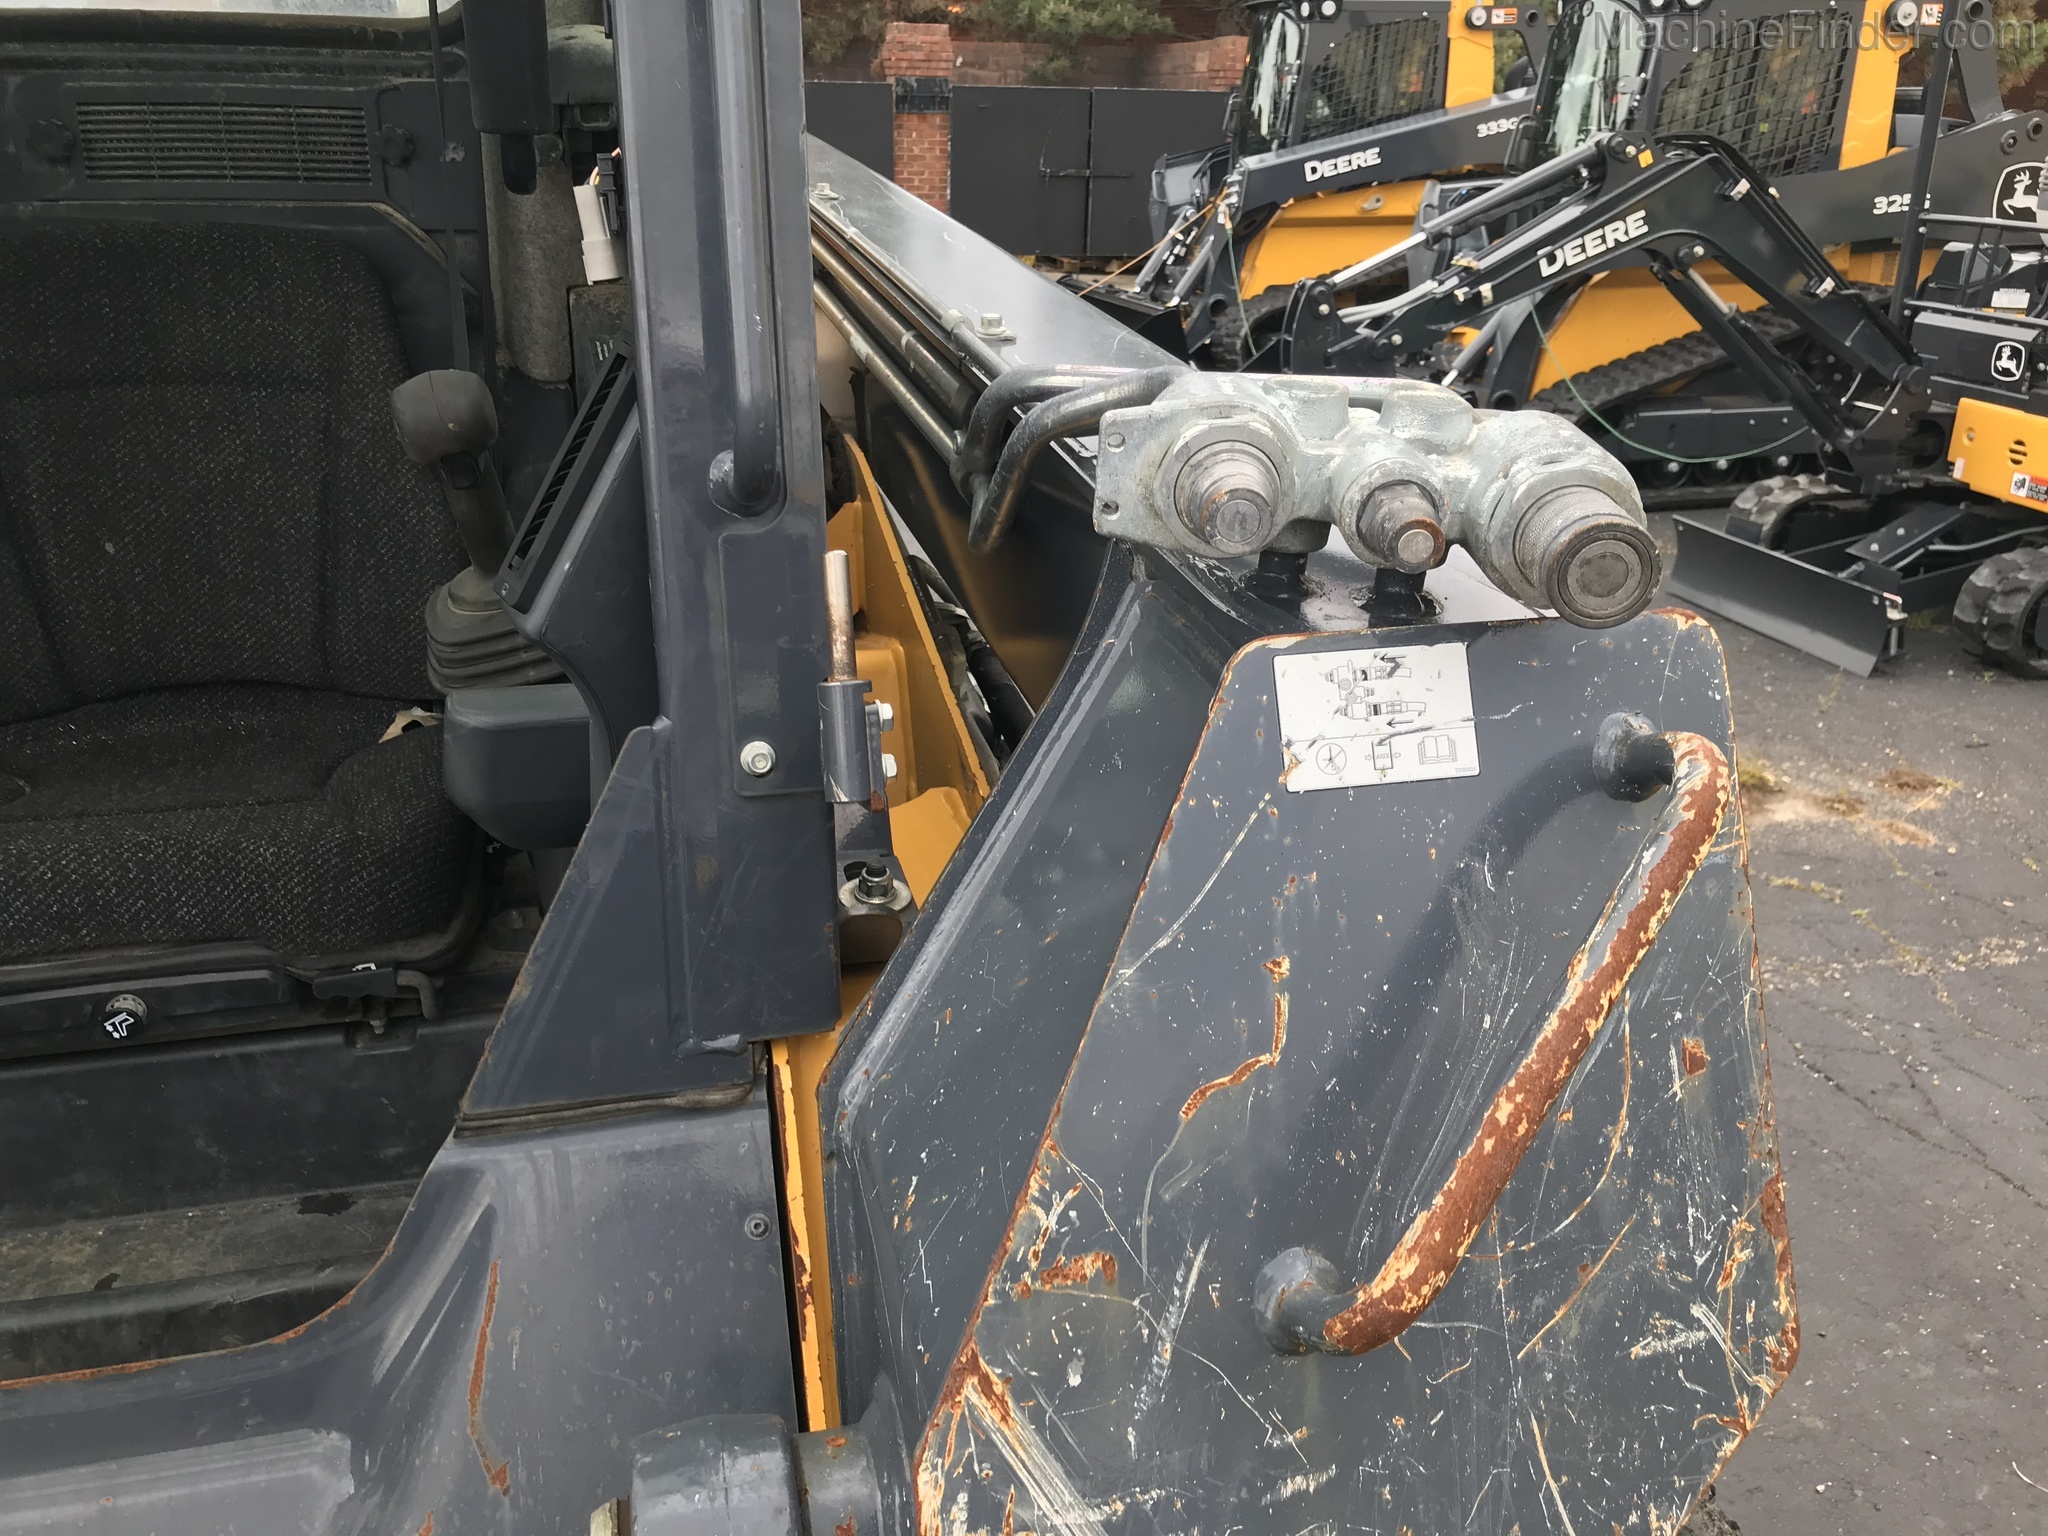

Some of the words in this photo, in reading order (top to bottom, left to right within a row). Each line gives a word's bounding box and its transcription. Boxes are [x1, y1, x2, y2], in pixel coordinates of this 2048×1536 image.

[1304, 147, 1381, 182] DEERE
[1537, 209, 1649, 278] DEERE
[1375, 752, 1390, 760] AUX
